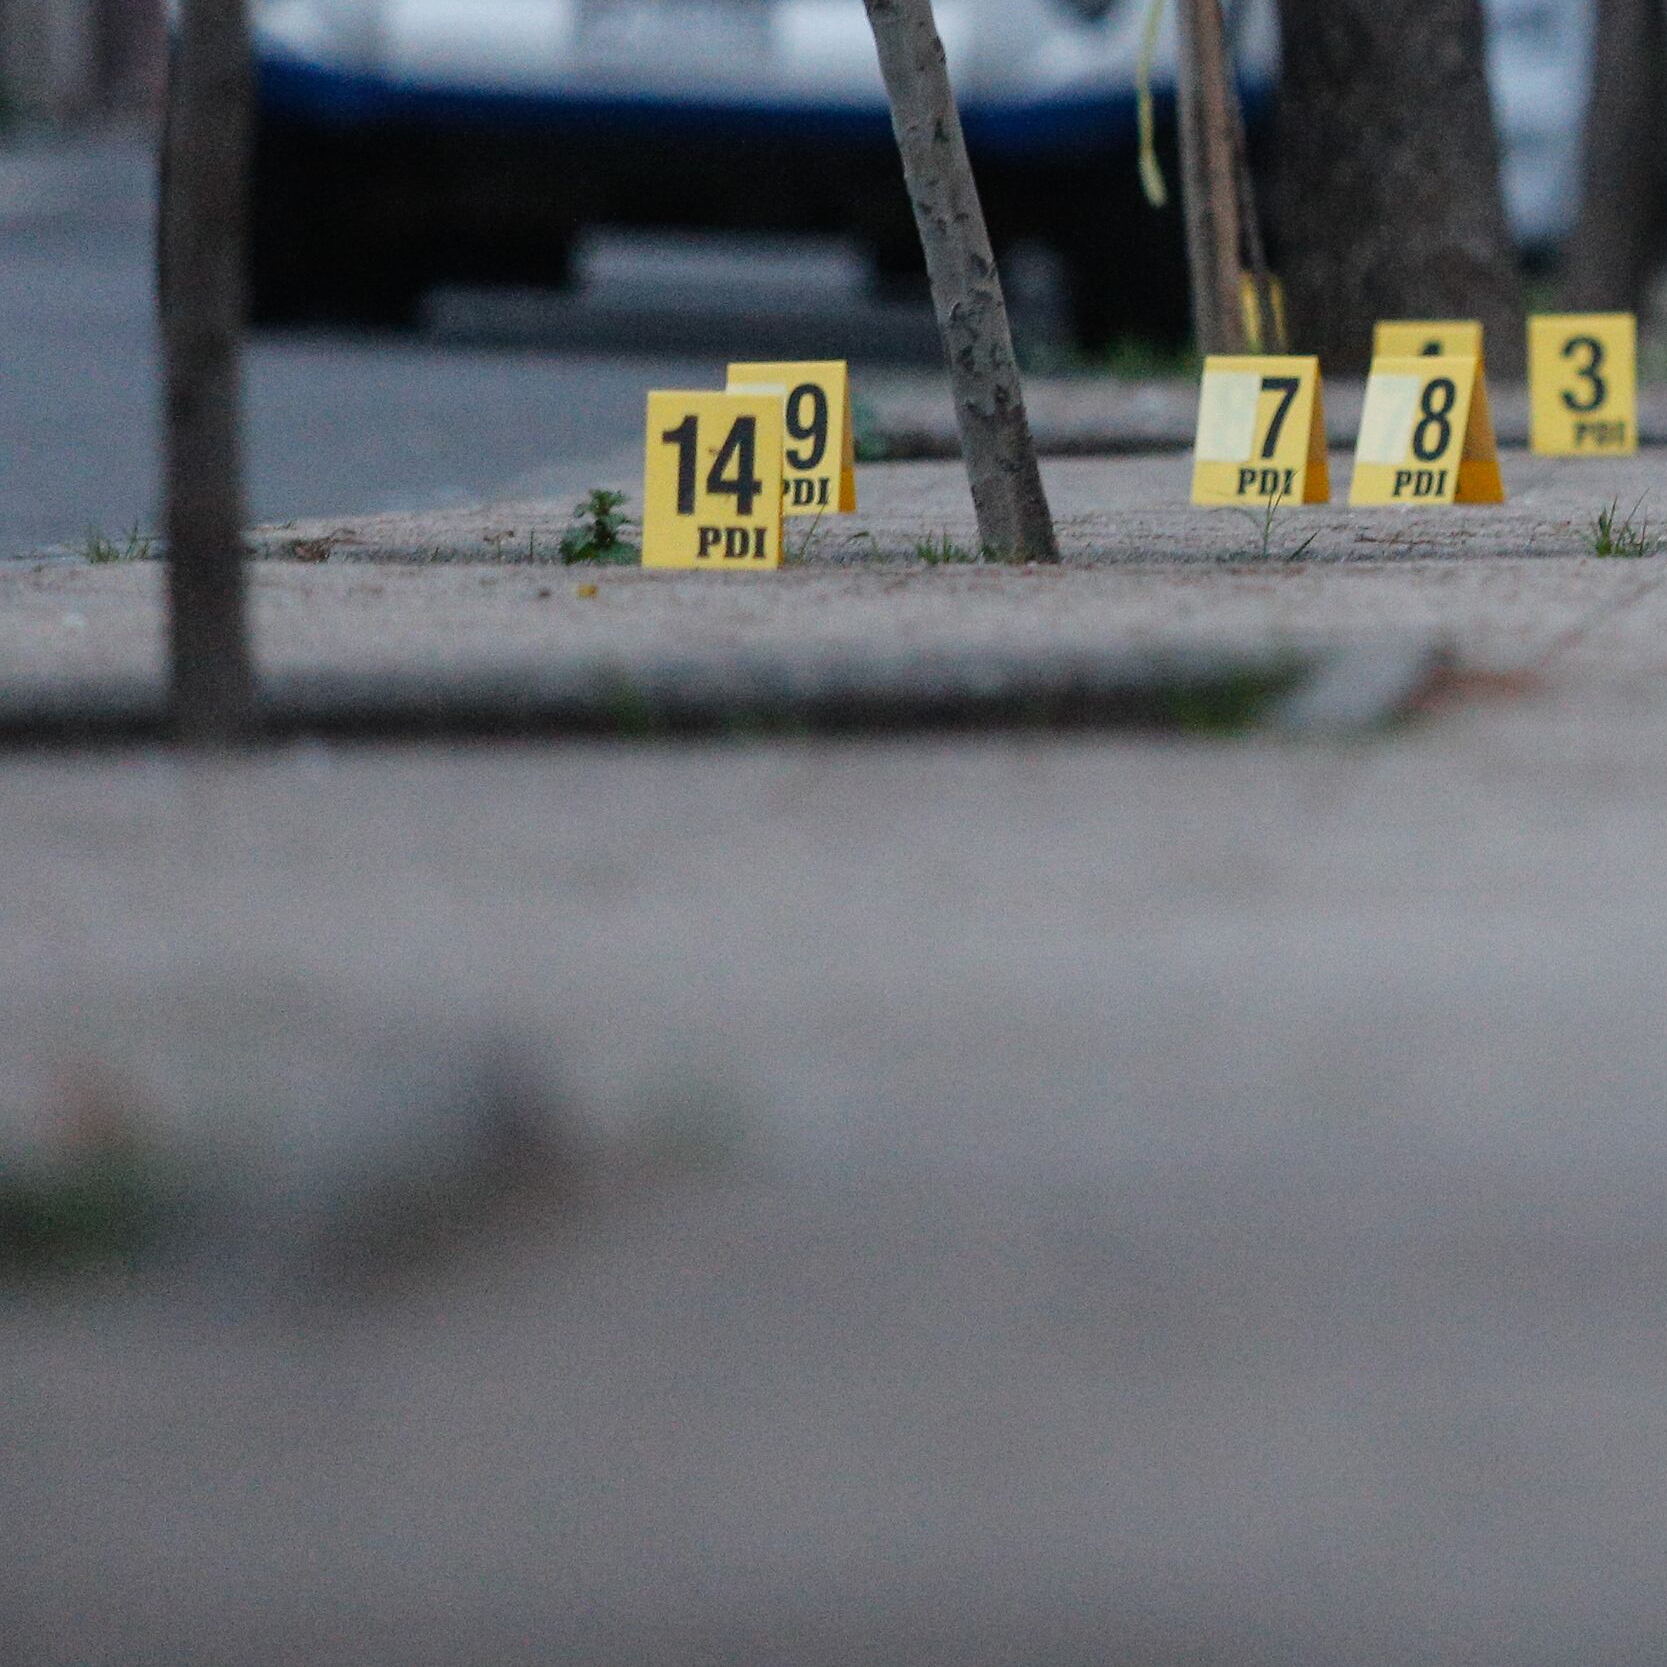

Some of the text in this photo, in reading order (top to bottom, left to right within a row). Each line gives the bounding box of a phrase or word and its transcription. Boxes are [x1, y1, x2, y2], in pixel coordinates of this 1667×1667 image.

[1562, 336, 1608, 412] 3
[786, 384, 828, 470] 9
[1261, 377, 1300, 459] 7
[1413, 377, 1456, 461] 8
[1574, 421, 1626, 446] PDI
[662, 415, 762, 516] 14
[1237, 468, 1294, 496] PDI
[1393, 470, 1448, 498] PDI
[697, 527, 767, 559] PDI
